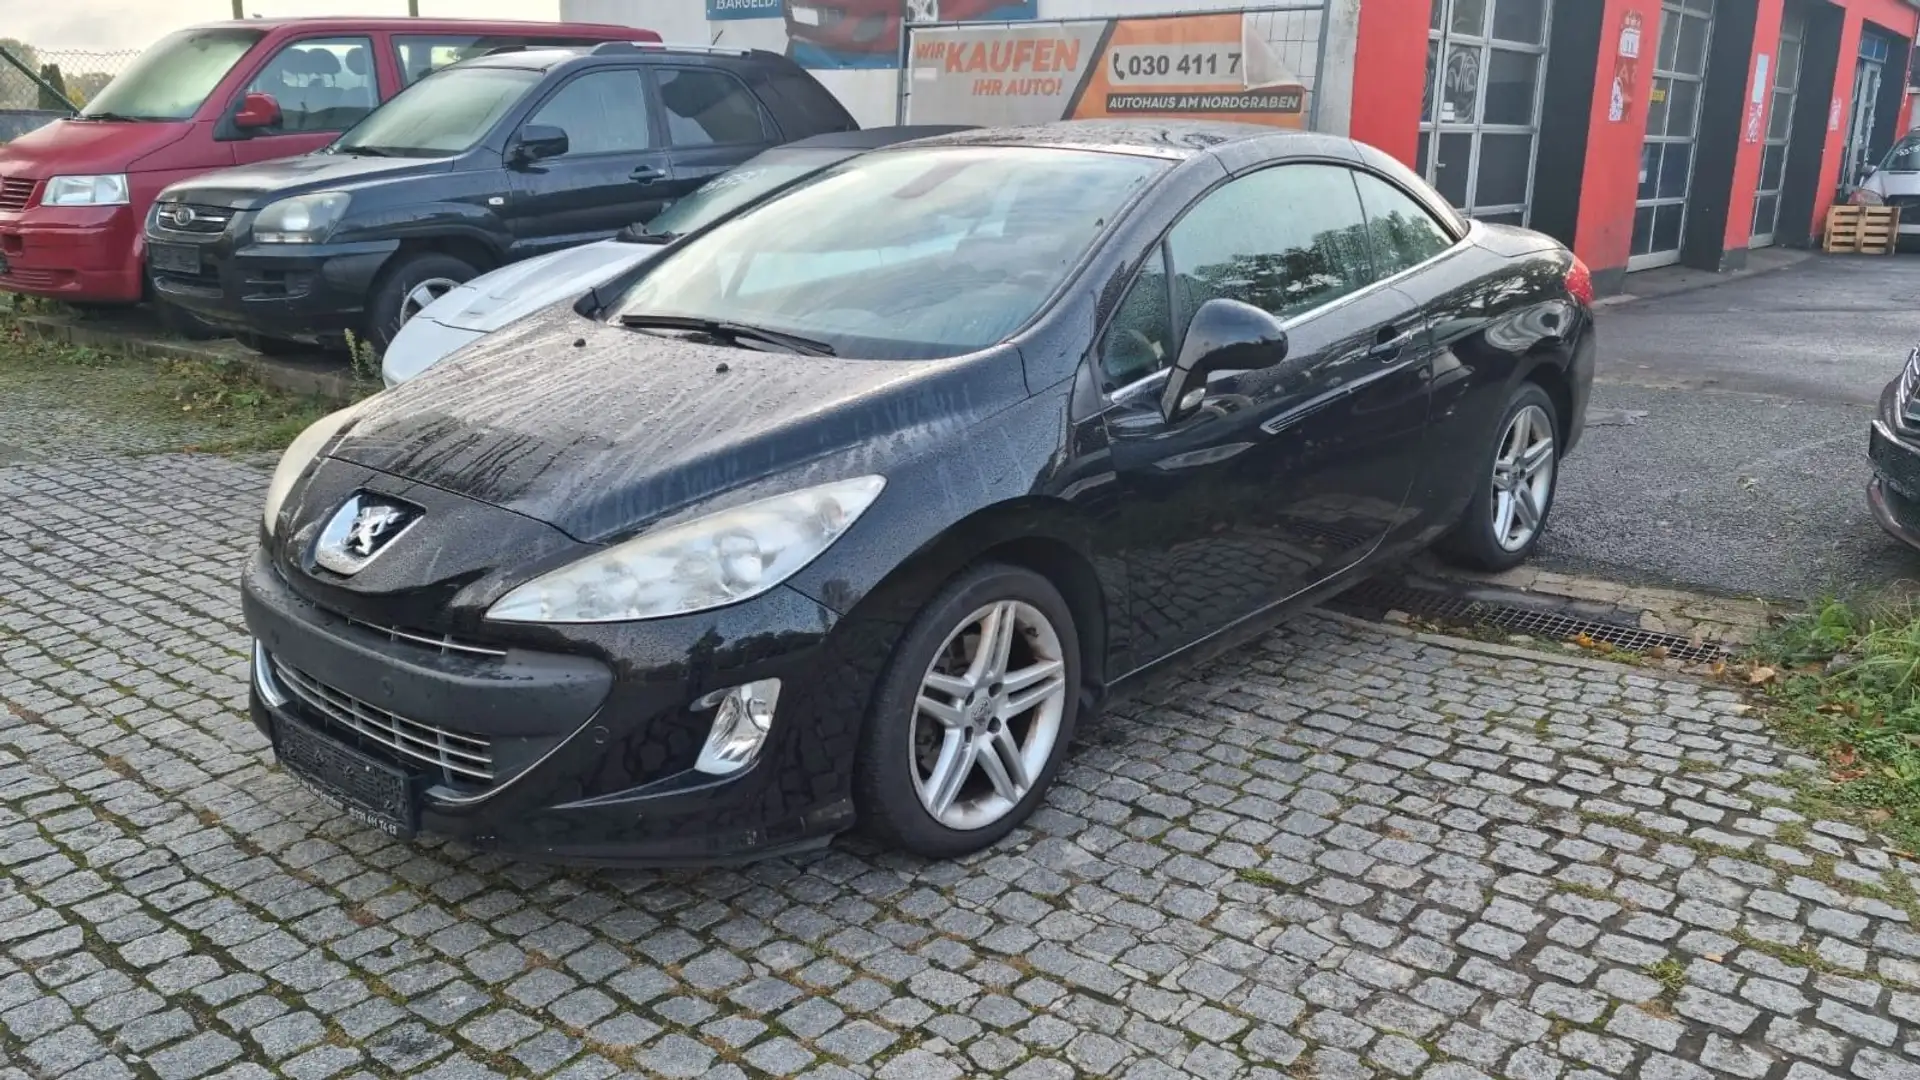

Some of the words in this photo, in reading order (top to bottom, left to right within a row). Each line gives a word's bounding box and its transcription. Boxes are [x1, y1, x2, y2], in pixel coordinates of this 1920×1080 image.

[716, 0, 778, 9] BARGELD!
[916, 40, 944, 60] WIR
[945, 38, 1081, 74] KAUFEN
[1128, 54, 1170, 76] 030
[1176, 53, 1217, 75] 411
[972, 78, 1001, 97] IHR
[1005, 78, 1063, 97] AUTO!
[1109, 97, 1176, 110] AUTOHAUS
[1178, 97, 1199, 109] AM
[1201, 96, 1299, 109] NORDGRABEN
